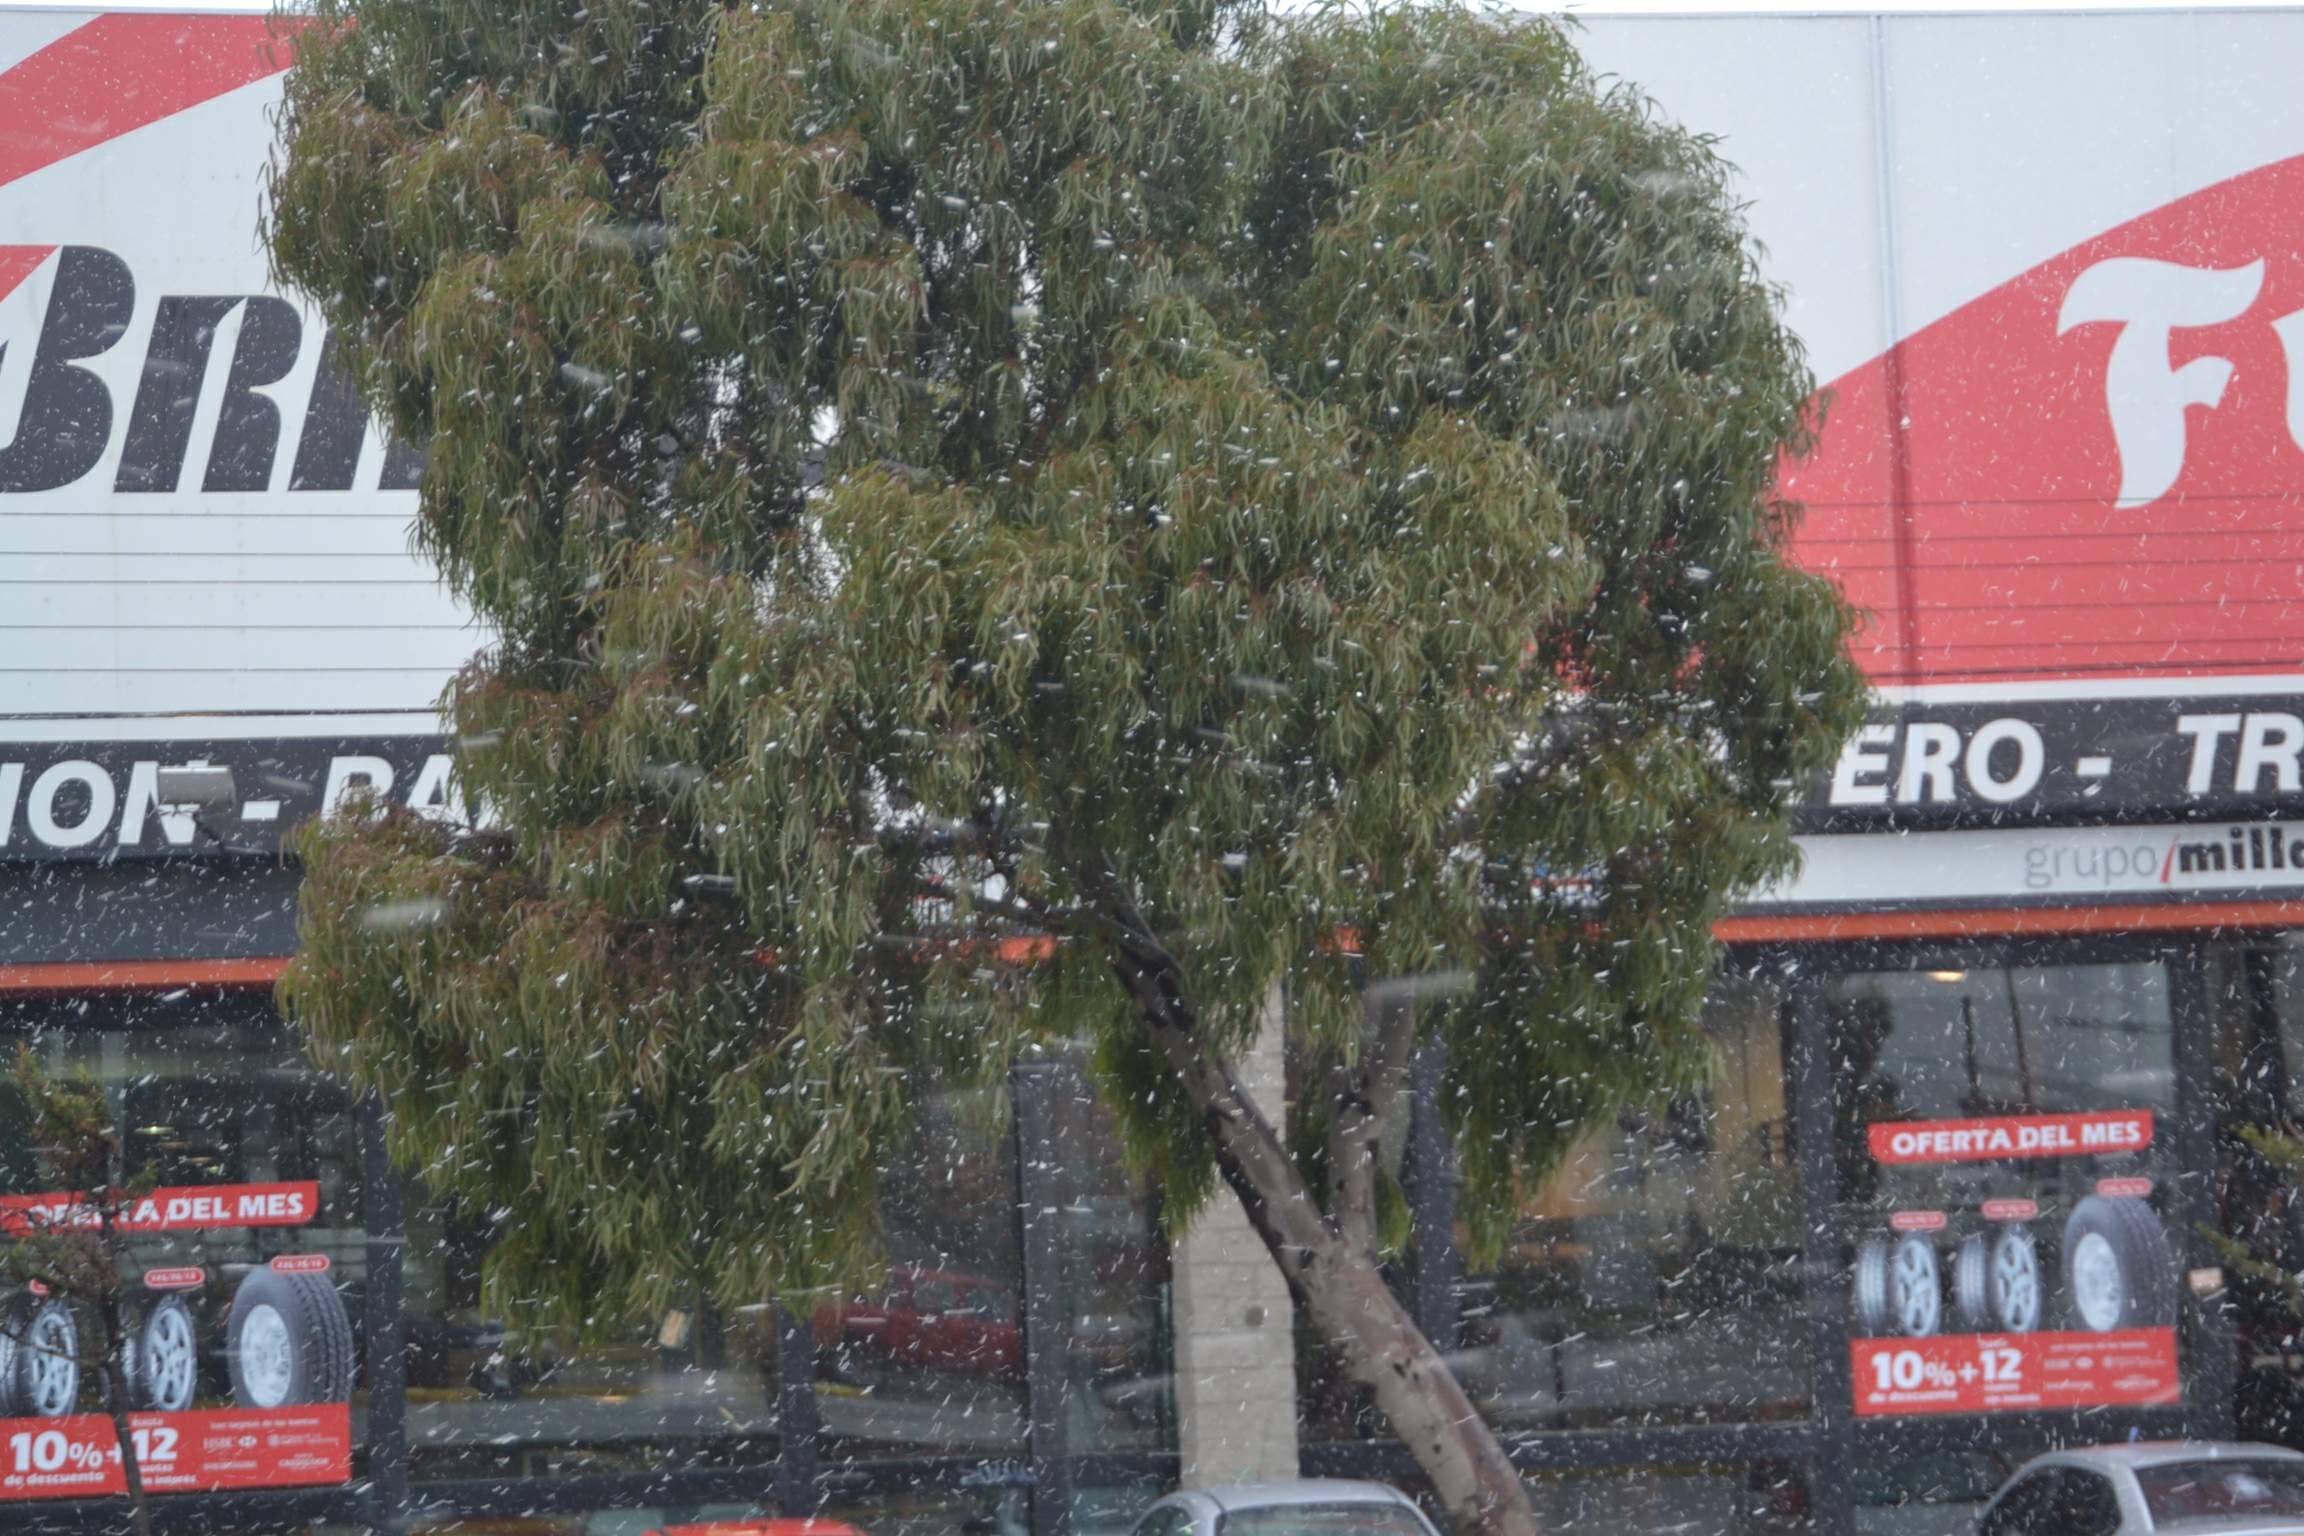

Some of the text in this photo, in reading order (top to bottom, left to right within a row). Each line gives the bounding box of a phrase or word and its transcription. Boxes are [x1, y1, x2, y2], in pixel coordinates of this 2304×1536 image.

[1891, 1120, 2141, 1155] OFERTA DEL MES
[168, 1196, 231, 1221] DEL
[238, 1192, 304, 1217] MES
